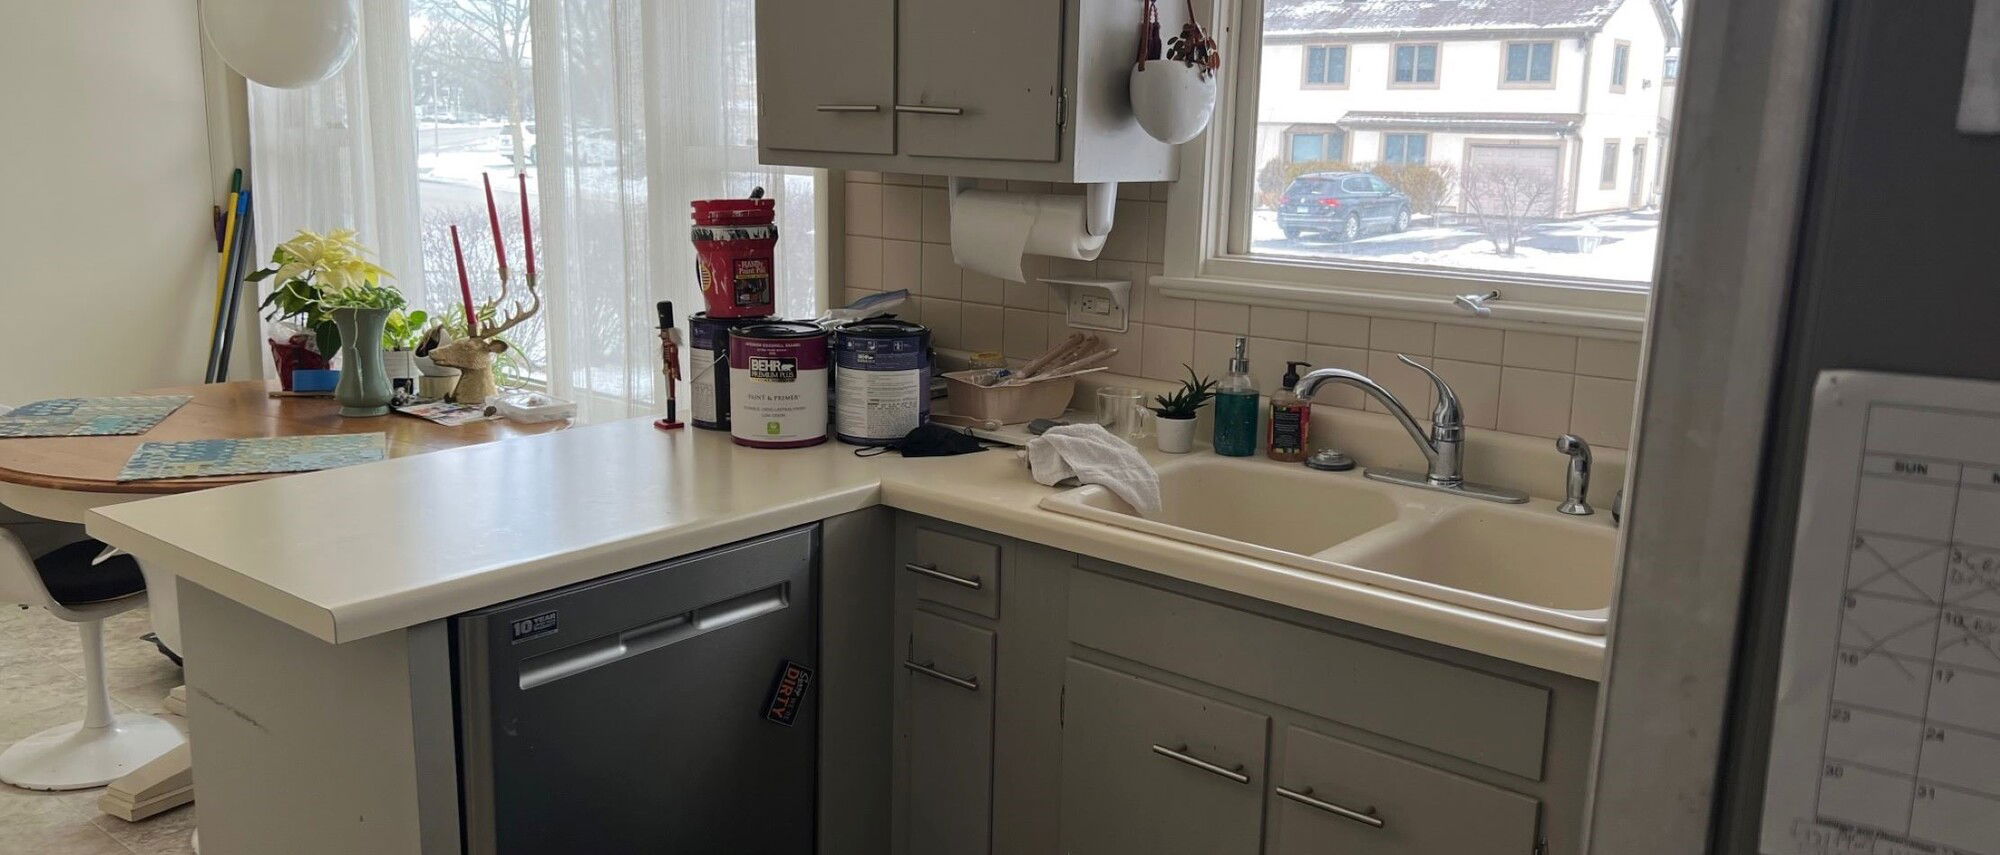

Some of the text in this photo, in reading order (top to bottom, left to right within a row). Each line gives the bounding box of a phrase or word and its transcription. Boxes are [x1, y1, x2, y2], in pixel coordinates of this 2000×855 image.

[751, 359, 781, 372] BEHR
[1895, 461, 1928, 475] SUN
[1945, 611, 1964, 626] 10
[514, 619, 533, 637] 10
[1936, 669, 1955, 683] 17
[772, 667, 800, 718] DIRTY
[1831, 707, 1851, 723] 23
[1925, 727, 1945, 743] 24
[1824, 763, 1844, 778] 30
[1917, 785, 1936, 800] 31
